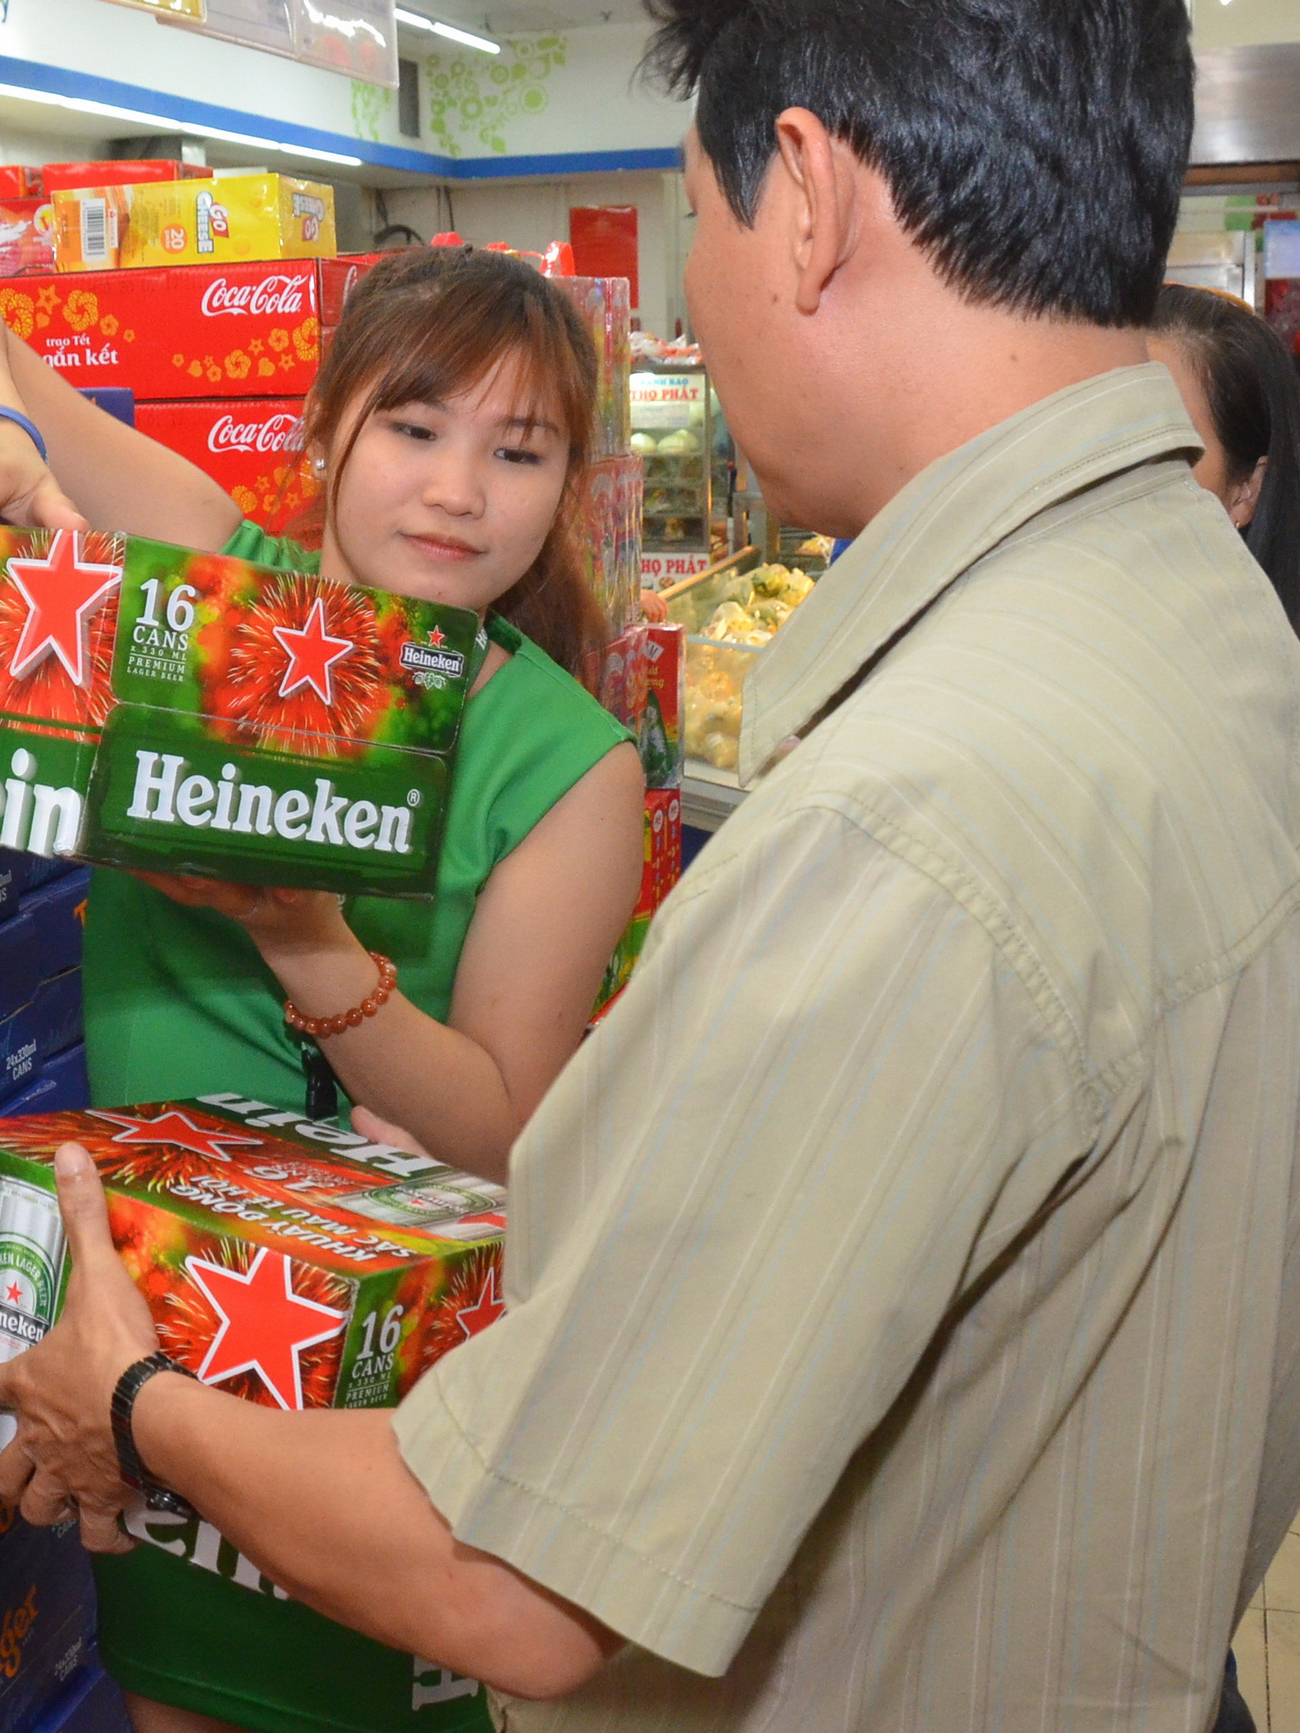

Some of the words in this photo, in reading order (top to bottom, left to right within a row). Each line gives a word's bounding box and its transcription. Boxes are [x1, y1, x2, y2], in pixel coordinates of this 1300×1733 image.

[170, 228, 185, 249] 20
[201, 274, 309, 318] Coca-Cola
[85, 342, 119, 366] kết
[641, 559, 662, 577] HỌ
[134, 577, 197, 632] 16
[132, 625, 190, 652] CANS
[127, 656, 187, 675] PREMIUM
[403, 647, 460, 672] Heineken
[126, 666, 156, 679] LAGER
[160, 671, 185, 683] BEER
[15, 1254, 41, 1282] LAGER
[356, 1304, 405, 1361] 16
[351, 1352, 395, 1380] CANS
[345, 1383, 390, 1403] PREMIUM
